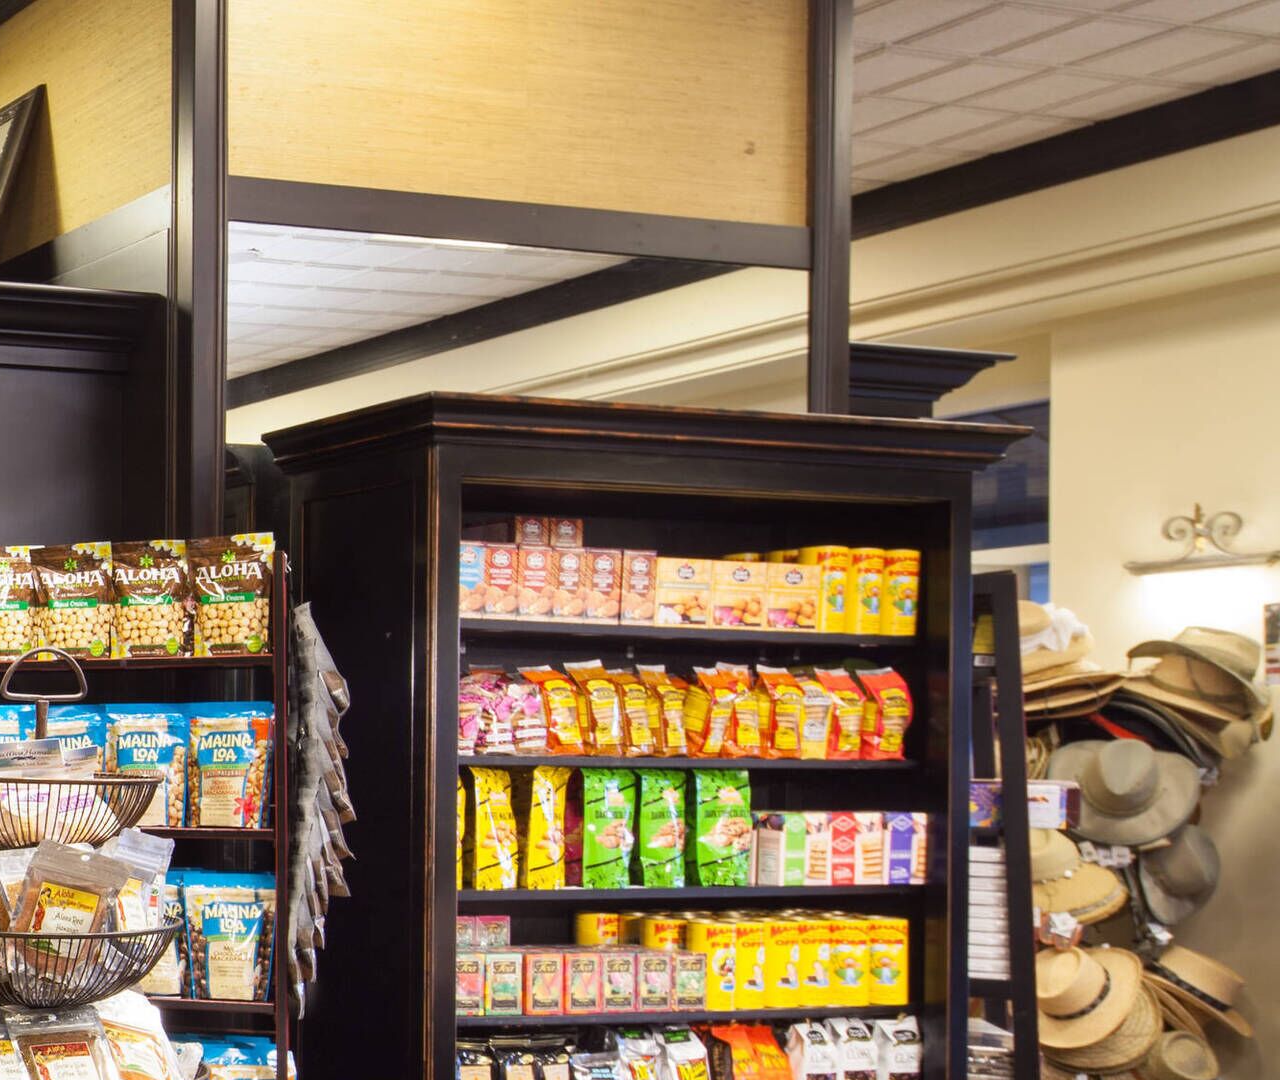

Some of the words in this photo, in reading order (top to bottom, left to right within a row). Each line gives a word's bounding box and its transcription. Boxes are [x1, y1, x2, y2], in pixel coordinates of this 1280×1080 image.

[40, 570, 105, 589] ALOHA
[115, 566, 181, 587] ALOHA
[196, 562, 263, 582] ALOHA
[118, 731, 174, 749] MAUNA
[200, 731, 253, 750] MAUNA
[132, 746, 160, 762] LOA
[212, 747, 238, 763] LOA
[204, 902, 262, 920] MAUNA
